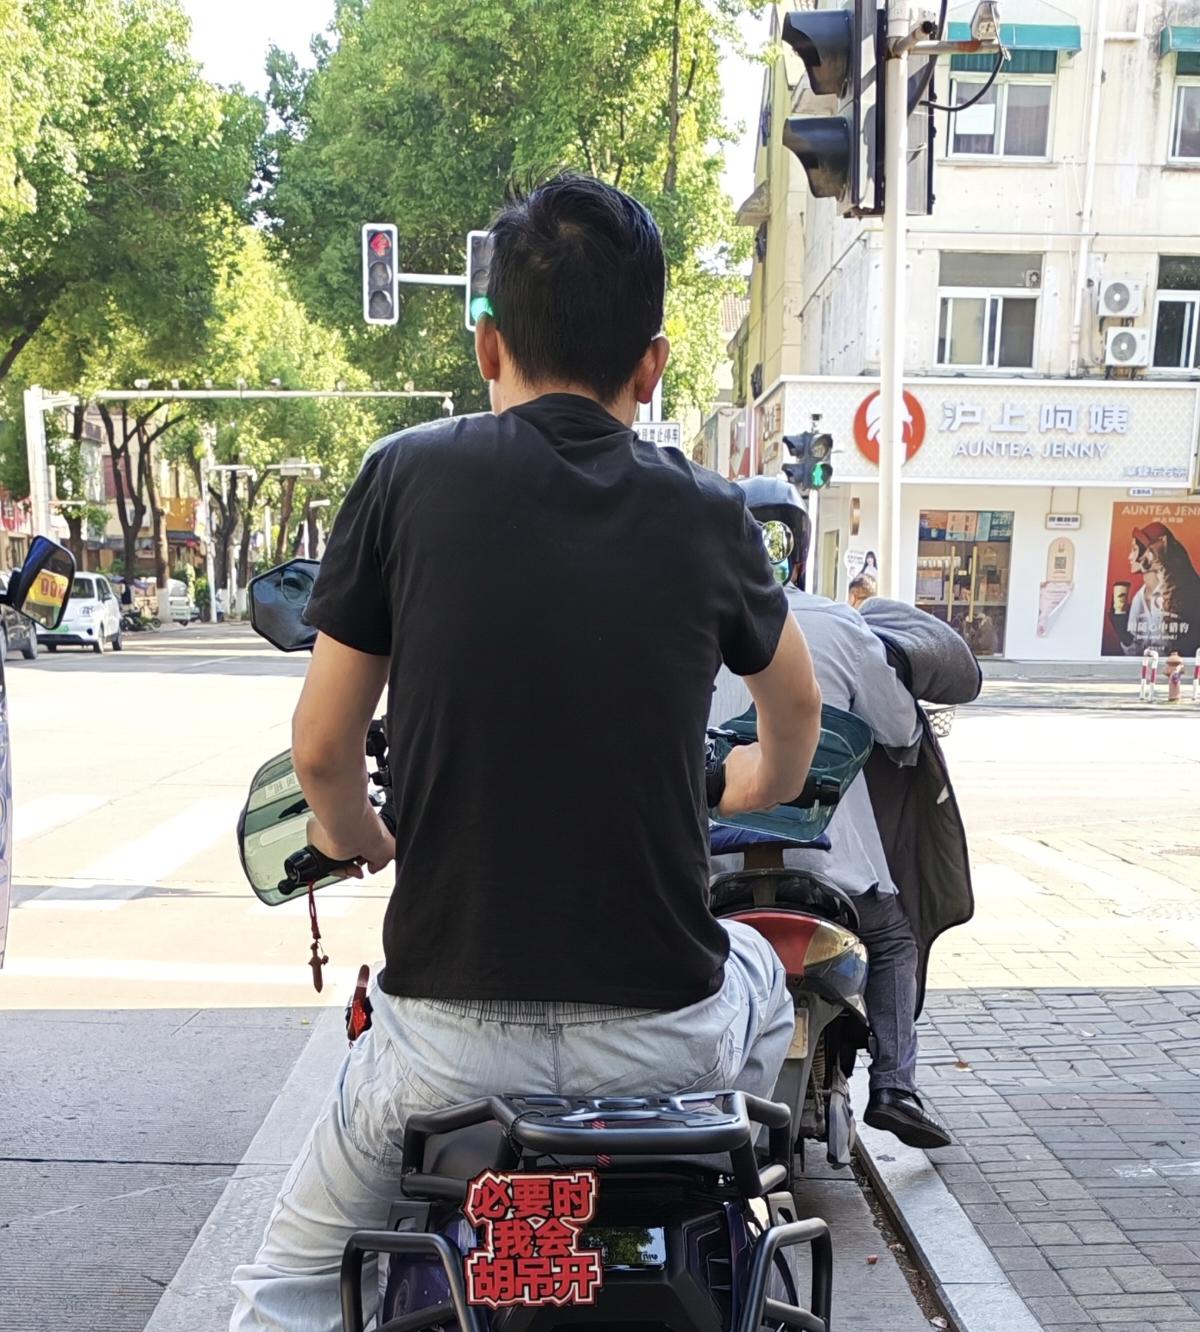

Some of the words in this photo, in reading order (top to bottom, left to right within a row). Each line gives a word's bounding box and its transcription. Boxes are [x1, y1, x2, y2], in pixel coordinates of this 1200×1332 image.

[939, 402, 1129, 434] 沪上阿姨
[954, 441, 1033, 458] AUNTEA
[1041, 442, 1107, 459] JENNY
[1121, 505, 1172, 516] AUNTEA
[473, 1178, 592, 1218] 必要时
[493, 1218, 572, 1256] 我会
[473, 1256, 596, 1300] 胡吊开
